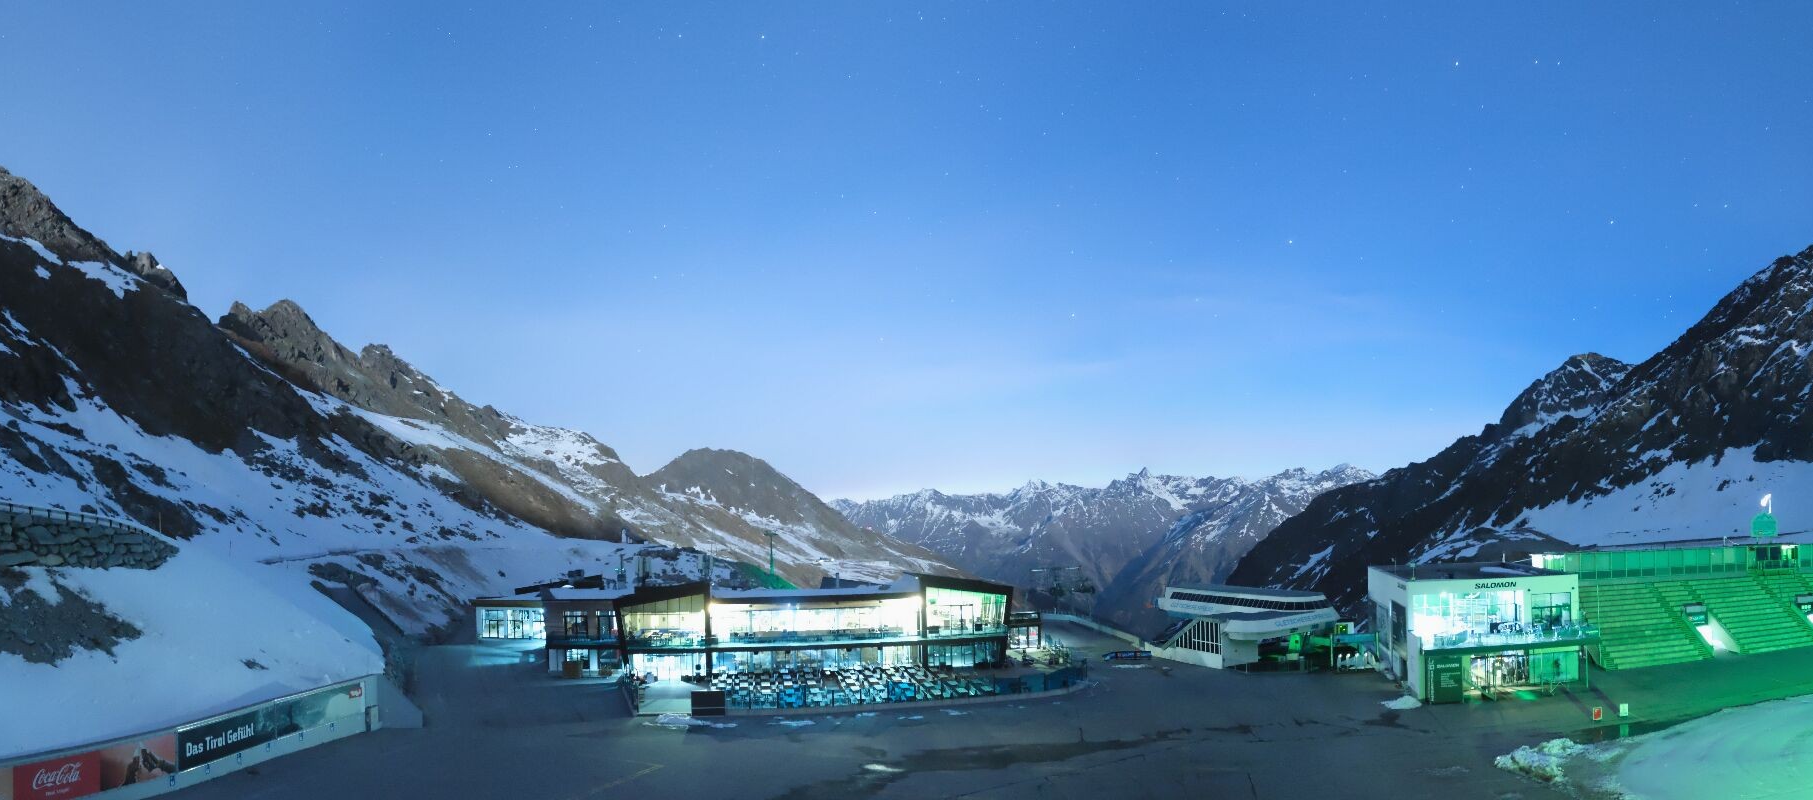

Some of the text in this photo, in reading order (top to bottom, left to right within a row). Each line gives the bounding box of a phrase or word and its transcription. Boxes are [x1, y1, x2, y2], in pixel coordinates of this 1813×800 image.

[1474, 581, 1517, 590] SALOMON
[186, 722, 255, 758] Das Tirol Gefühl
